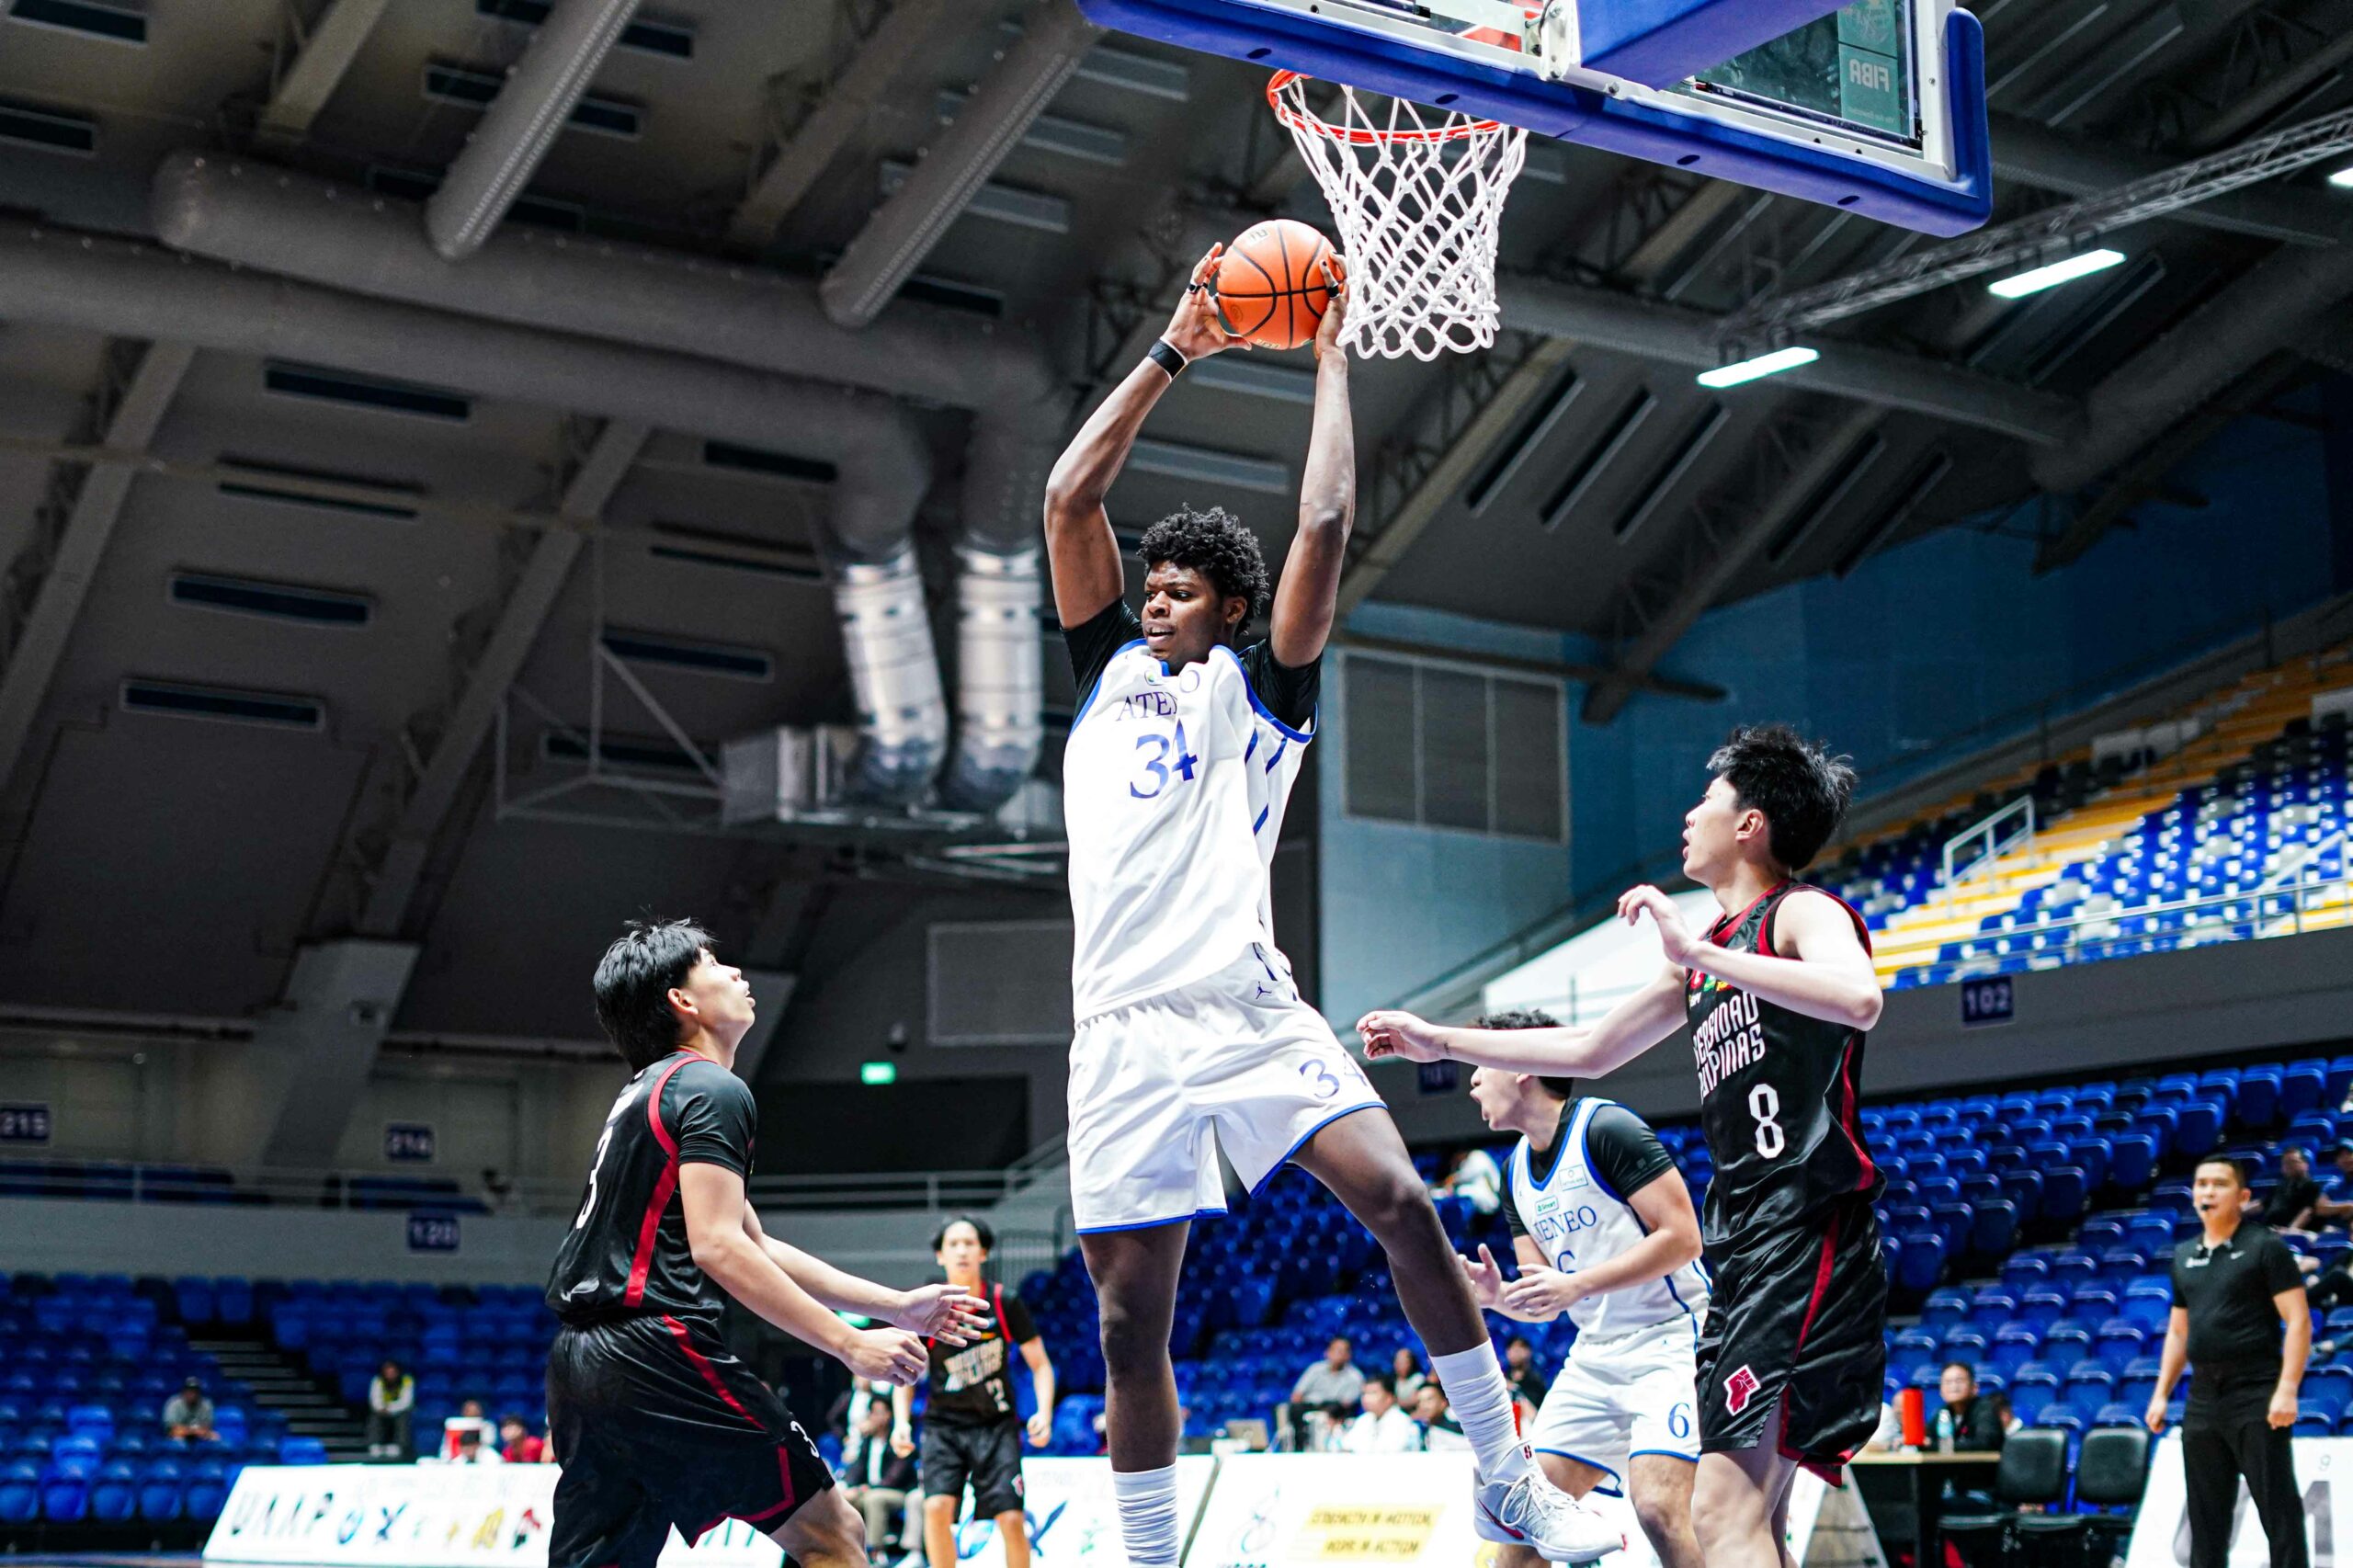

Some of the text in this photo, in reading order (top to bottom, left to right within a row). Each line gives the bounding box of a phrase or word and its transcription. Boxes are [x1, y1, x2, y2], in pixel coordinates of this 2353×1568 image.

[1116, 670, 1200, 722] ATEO
[1130, 718, 1199, 799] 34
[1967, 983, 2010, 1016] 102
[1299, 1052, 1368, 1099] 34
[1748, 1083, 1786, 1160] 8
[790, 1420, 820, 1459] 3
[1667, 1403, 1691, 1439] 6
